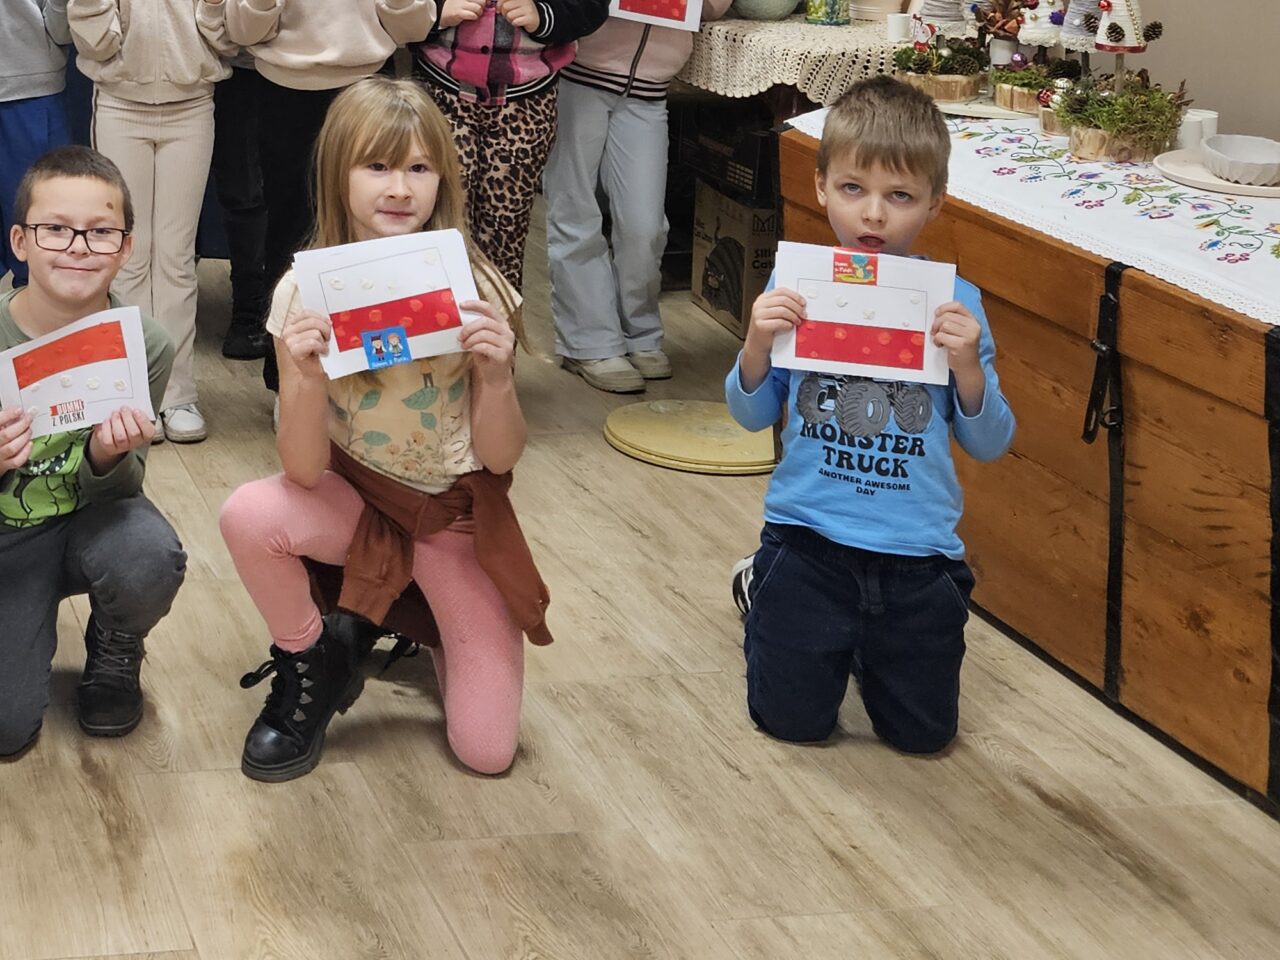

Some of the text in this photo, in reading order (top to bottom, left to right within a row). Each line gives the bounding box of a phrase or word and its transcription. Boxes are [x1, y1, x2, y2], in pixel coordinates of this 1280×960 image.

[59, 411, 85, 425] POLSKI
[799, 420, 926, 457] MONSTER
[822, 445, 909, 478] TRUCK
[818, 467, 911, 491] ANOTHER AWESOME
[855, 486, 876, 496] DAY
